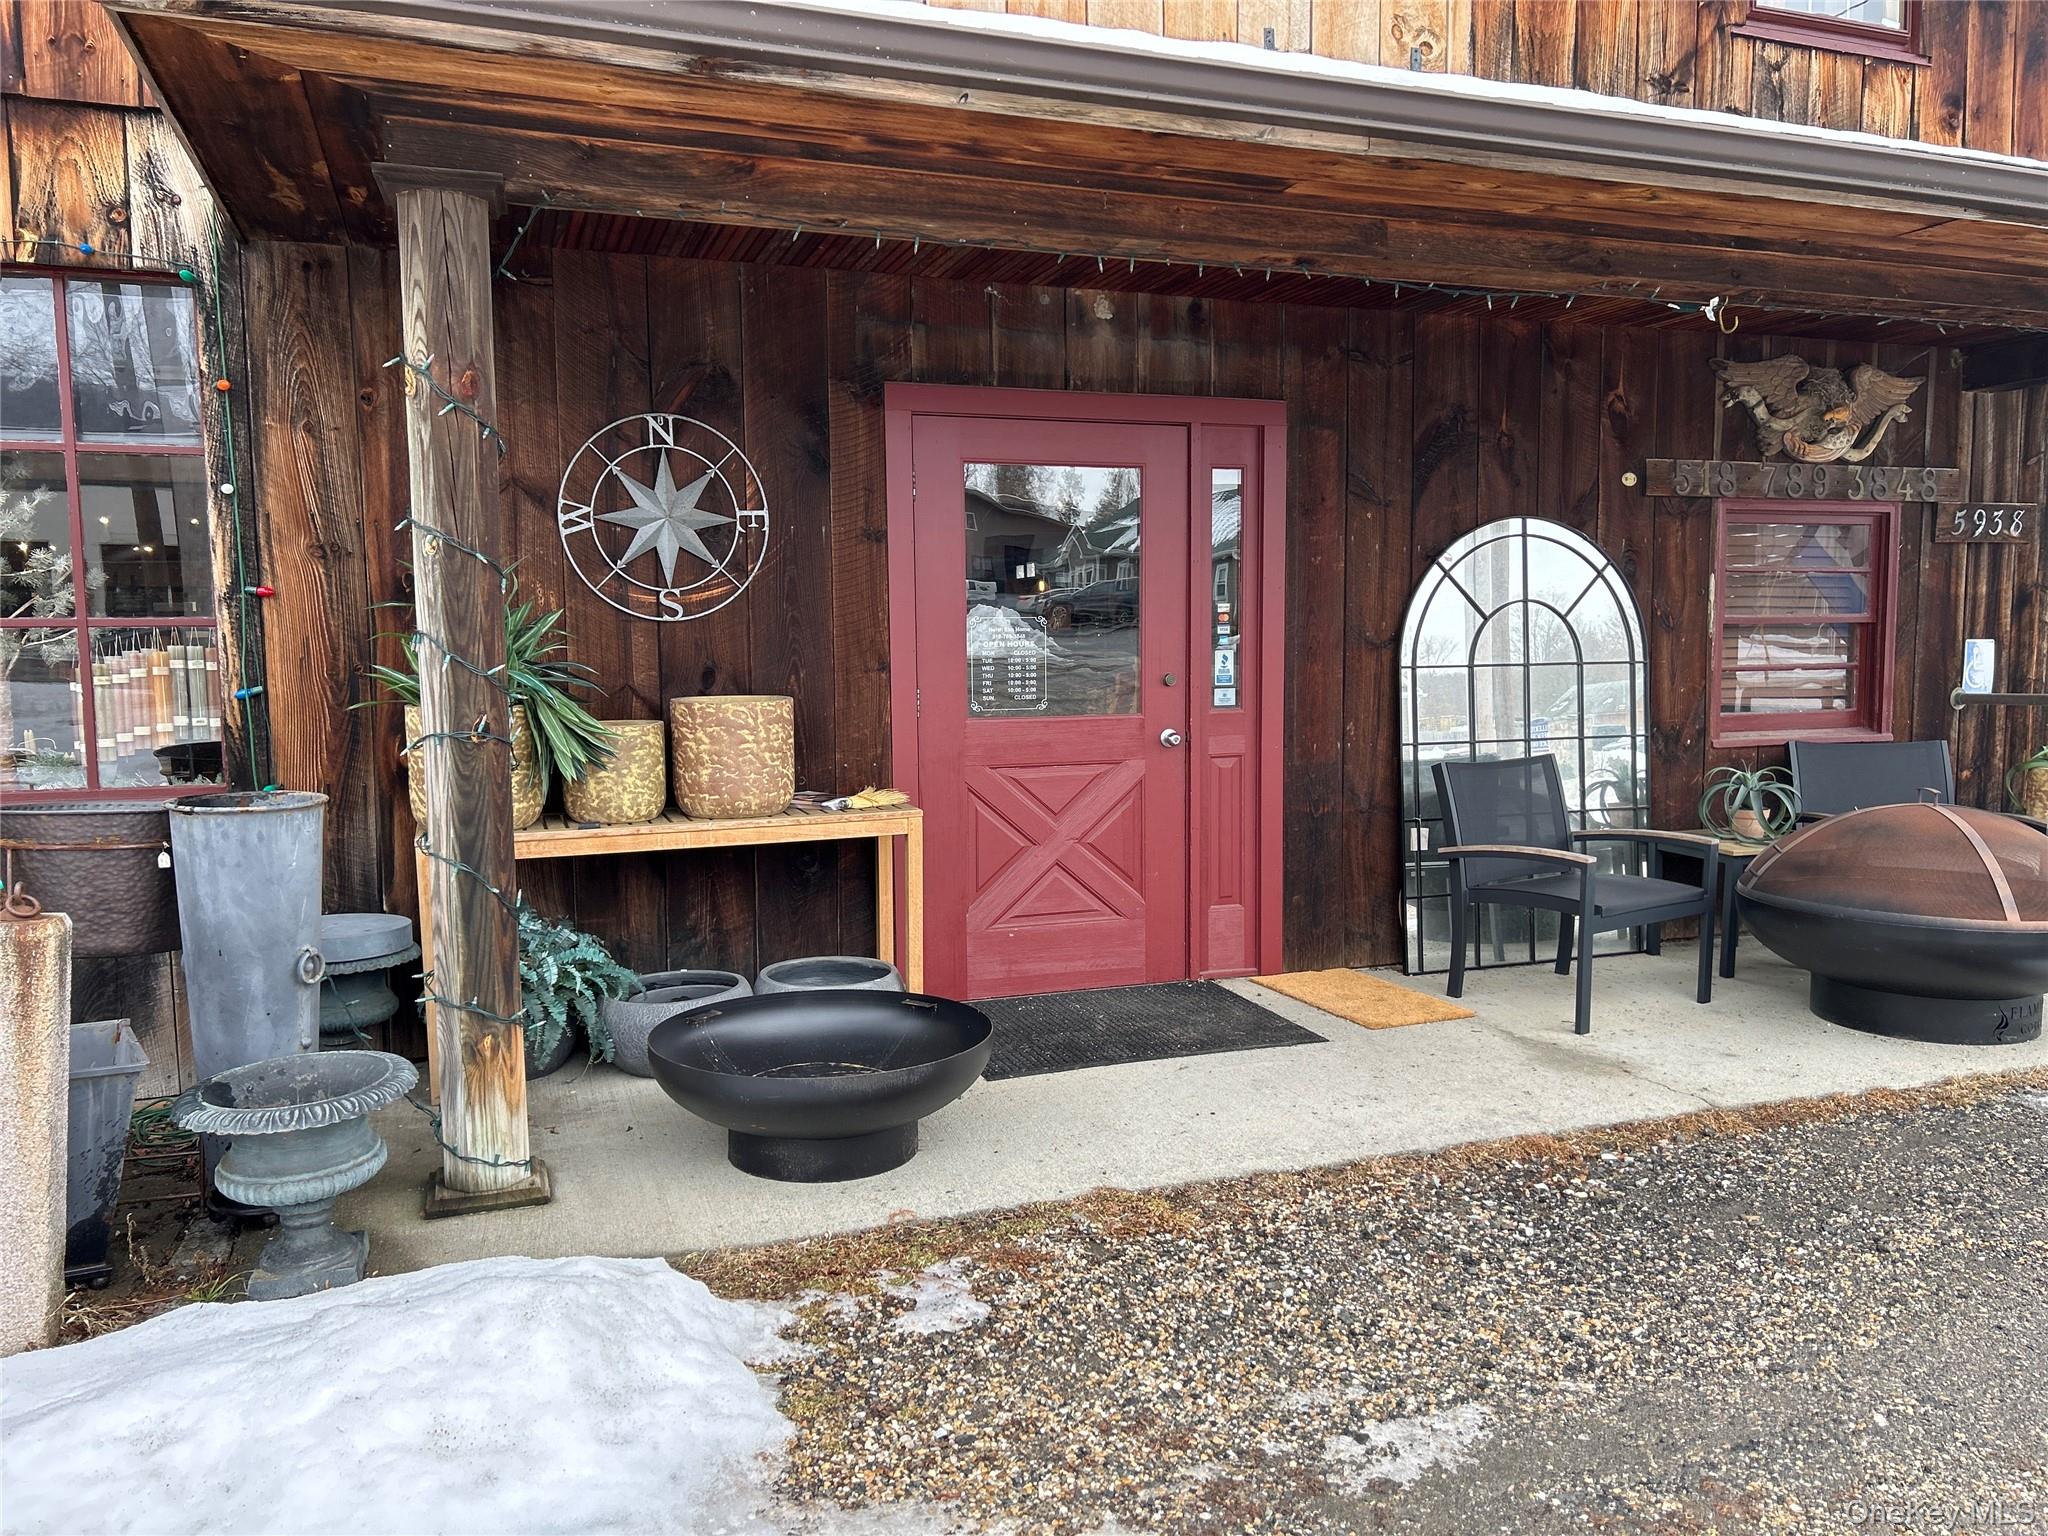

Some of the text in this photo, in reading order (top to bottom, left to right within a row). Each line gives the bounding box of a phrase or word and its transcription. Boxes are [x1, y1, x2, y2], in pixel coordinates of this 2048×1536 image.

[644, 414, 675, 448] N
[1675, 461, 1938, 501] 518 789 3848
[736, 507, 769, 533] E
[1951, 508, 2026, 538] 5938
[659, 589, 684, 621] S
[1007, 640, 1036, 648] HOURS
